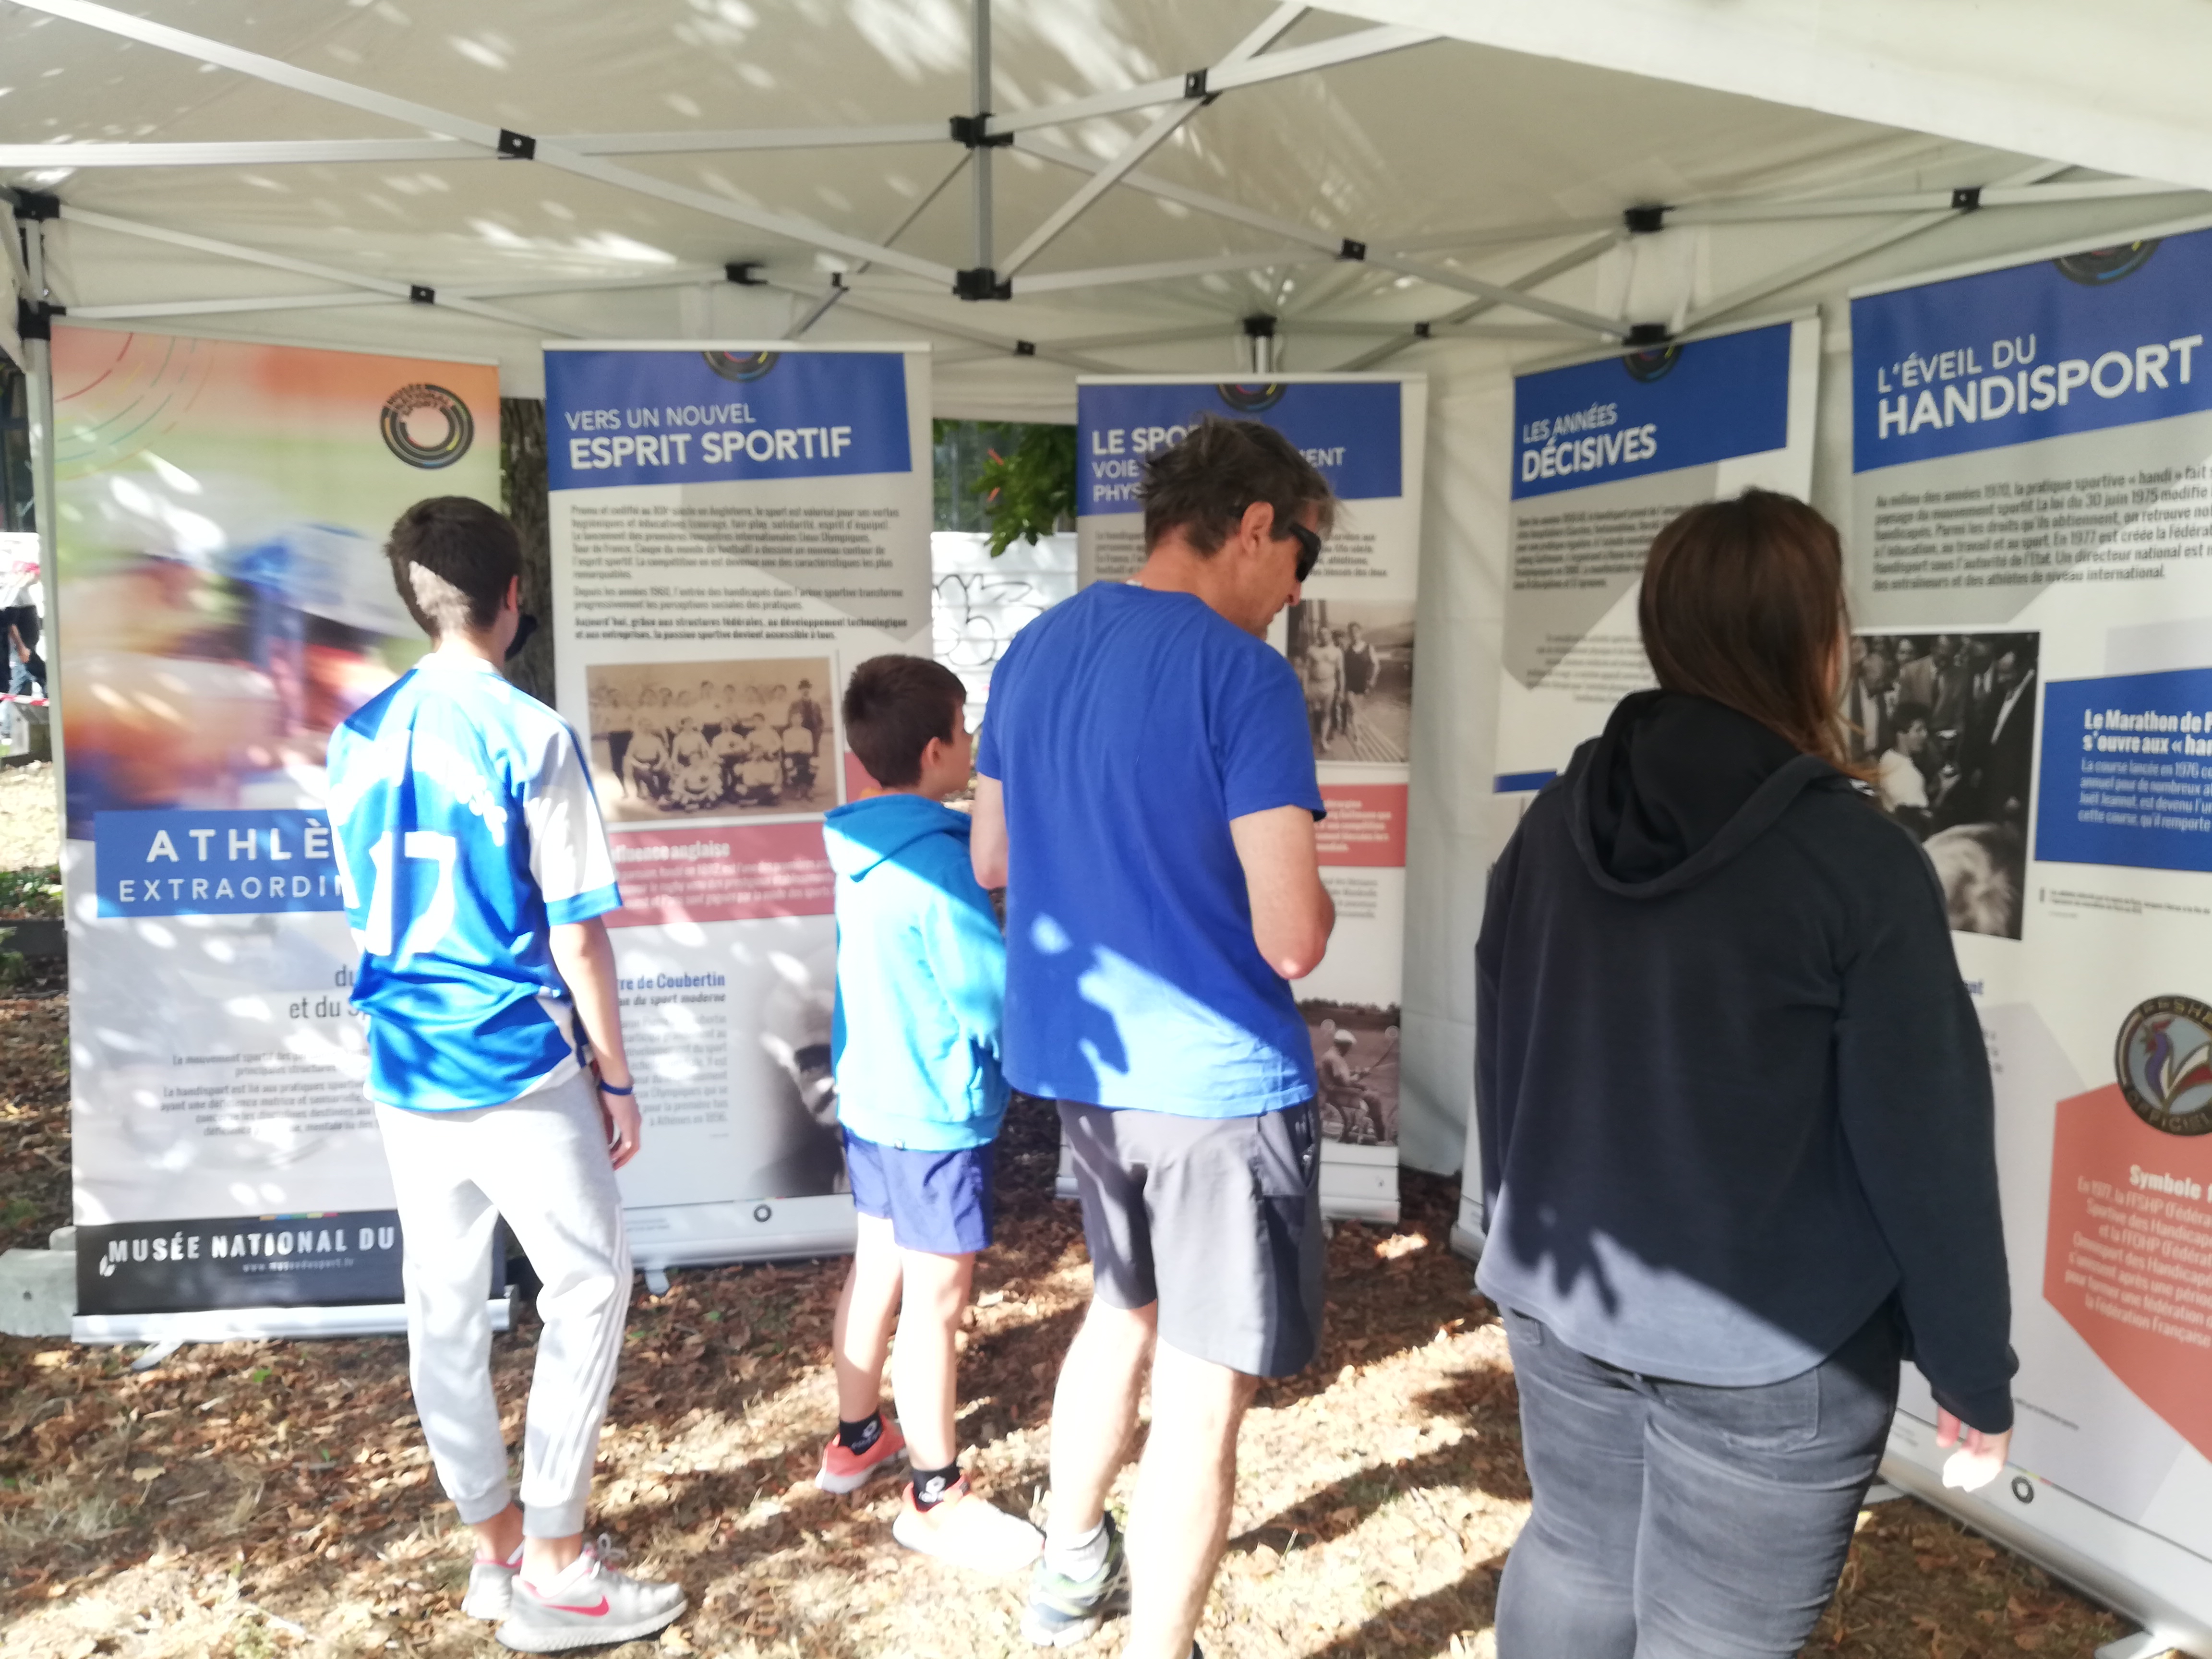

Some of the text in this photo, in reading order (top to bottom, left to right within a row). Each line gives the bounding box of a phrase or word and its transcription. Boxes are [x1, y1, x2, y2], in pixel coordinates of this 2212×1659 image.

[1877, 333, 2036, 393] L'ÉVEIL DU
[1877, 334, 2203, 440] HANDISPORT
[565, 403, 756, 432] VERS UN NOUVEL
[1523, 401, 1618, 444] LES ANNÉES
[570, 426, 852, 469] ESPRIT SPORTIF
[1092, 424, 1201, 456] LE SPO
[1522, 422, 1657, 482] DÉCISIVES
[1092, 459, 1140, 479] VOIE
[2185, 466, 2206, 480] fait
[2161, 484, 2208, 500] modifie
[2140, 505, 2191, 520] retrouve
[2155, 525, 2166, 539] la
[2074, 546, 2133, 562] directeur
[2134, 543, 2182, 559] national
[2184, 541, 2204, 556] est
[2084, 708, 2104, 730] Le
[2105, 709, 2178, 733] Marathon
[2180, 710, 2202, 733] de
[2082, 730, 2140, 754] s'ouvre
[2141, 736, 2169, 755] aux
[2150, 780, 2201, 796] nombreux
[2155, 795, 2193, 813] devenu
[2161, 816, 2211, 833] remporte
[146, 818, 330, 863] ATHLÈ
[670, 841, 730, 861] anglaise
[637, 975, 653, 989] de
[657, 972, 726, 989] Coubertin
[289, 995, 340, 1019] et du
[650, 993, 677, 1007] sport
[680, 991, 726, 1003] moderne
[2130, 1164, 2202, 1200] Symbole
[108, 1226, 395, 1263] MUSÉE NATIONAL DU
